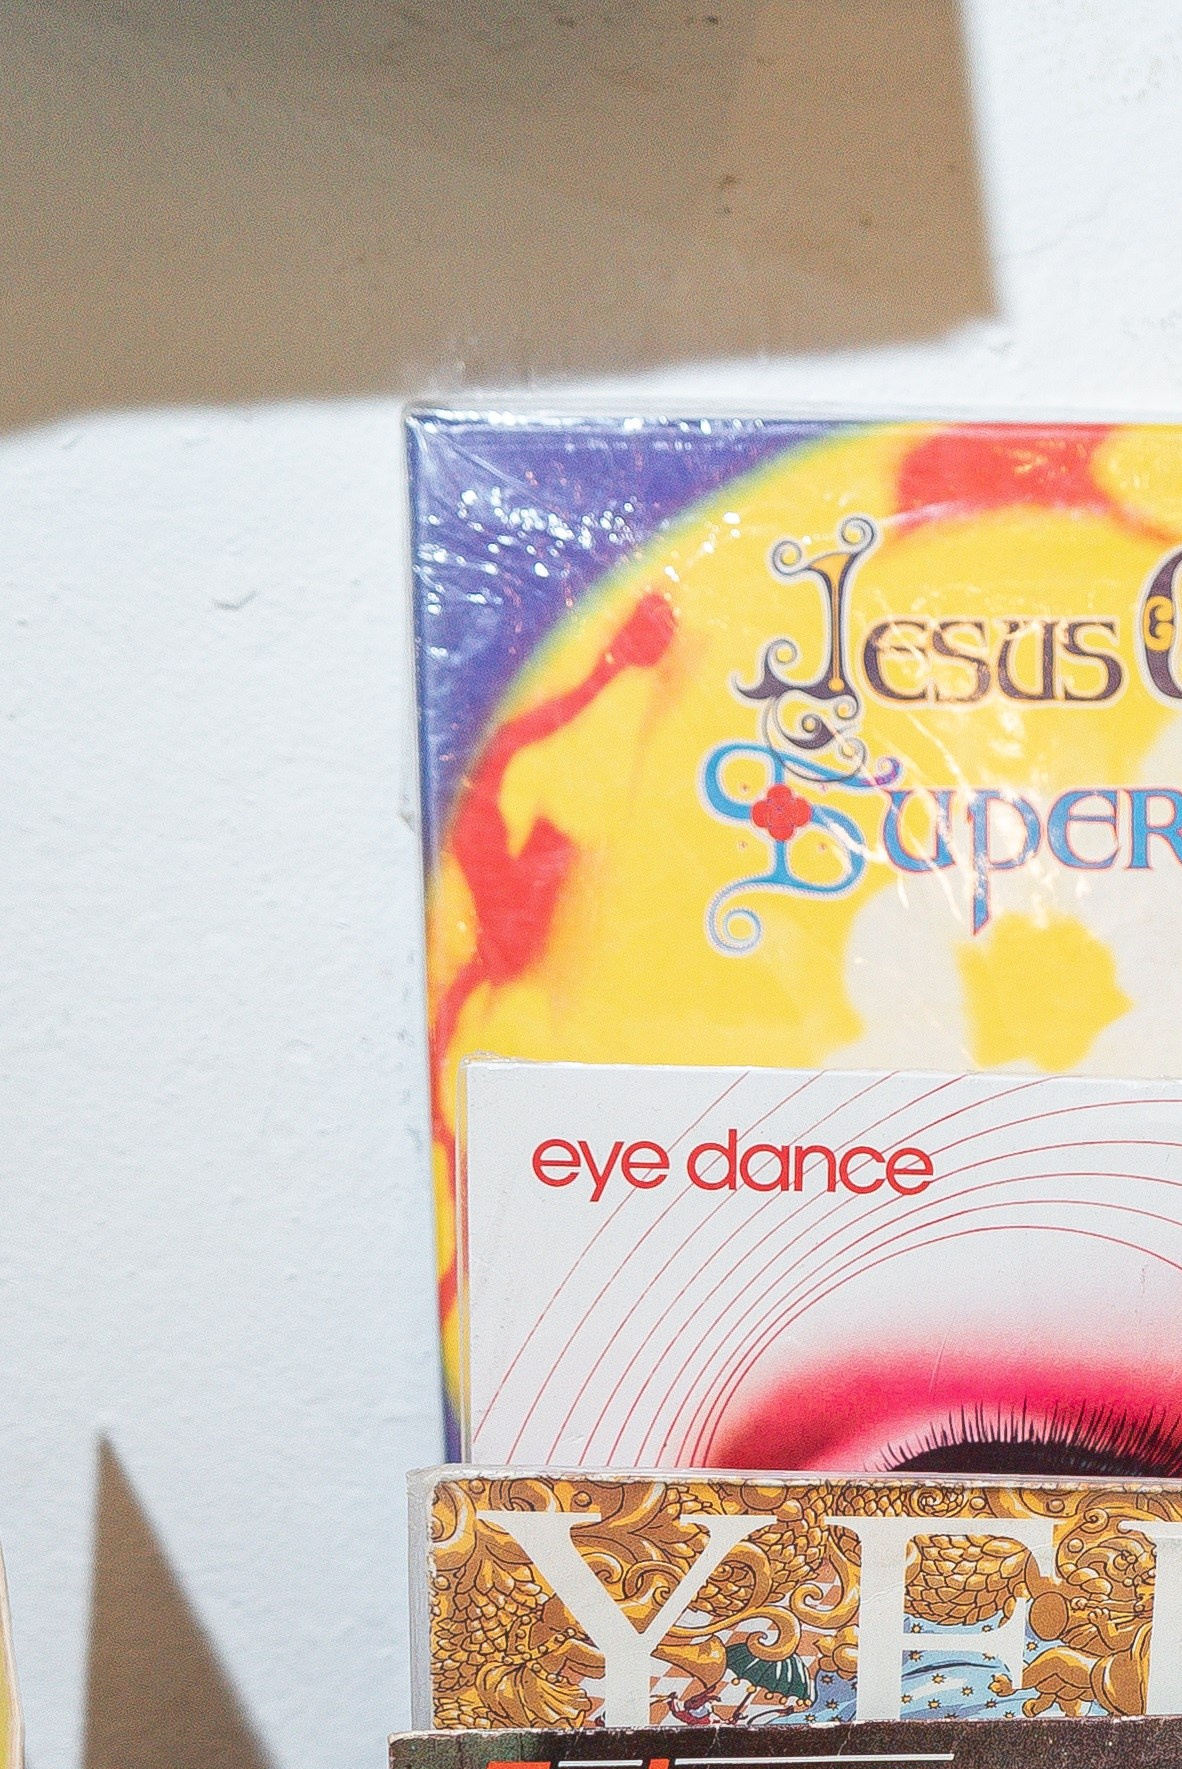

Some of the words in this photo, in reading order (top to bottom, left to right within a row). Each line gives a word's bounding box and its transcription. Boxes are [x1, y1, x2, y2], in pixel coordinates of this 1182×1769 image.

[732, 517, 1124, 755] JESUS
[532, 1138, 669, 1201] eye
[687, 1129, 933, 1196] dance
